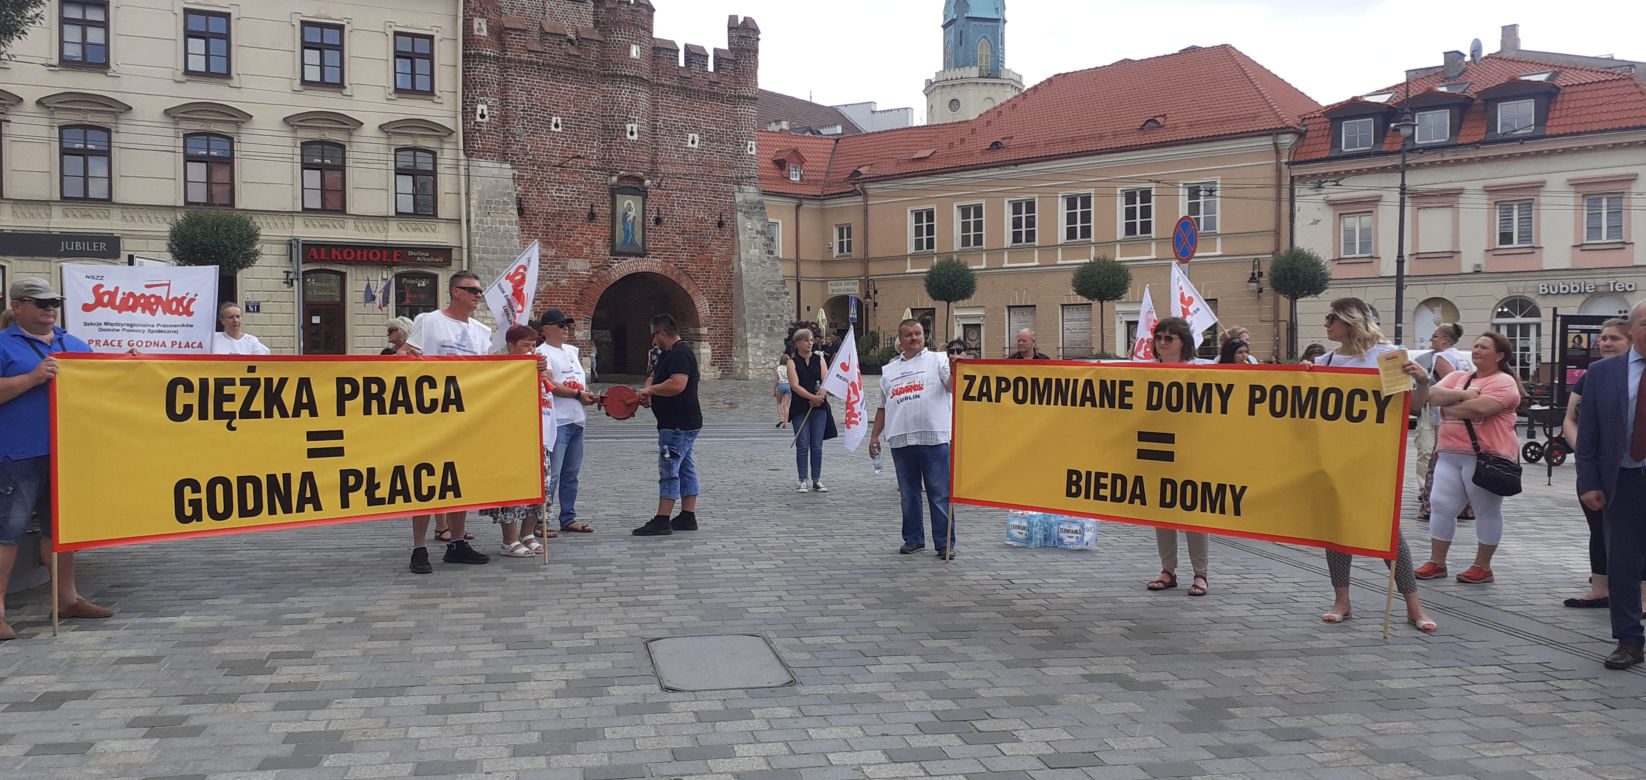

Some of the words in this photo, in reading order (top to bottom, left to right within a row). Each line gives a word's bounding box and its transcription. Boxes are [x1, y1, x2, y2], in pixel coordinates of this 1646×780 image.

[60, 240, 107, 252] JUBILER
[307, 247, 403, 262] ALKOHOLE
[1539, 281, 1596, 295] Bubble
[1608, 279, 1636, 292] Tea
[87, 339, 123, 350] PRACĘ
[127, 339, 167, 348] GODNA
[171, 340, 204, 349] PŁACA
[165, 365, 319, 432] CIĘŻKA
[336, 375, 465, 417] PRACA
[896, 394, 921, 404] LUBLIN
[962, 374, 1134, 410] ZAPOMNIANE
[1146, 380, 1235, 415] DOMY
[1248, 384, 1394, 425] POMOCY
[173, 471, 323, 525] GODNA
[339, 461, 462, 509] PŁACA
[1065, 468, 1148, 506] BIEDA
[1159, 478, 1248, 517] DOMY
